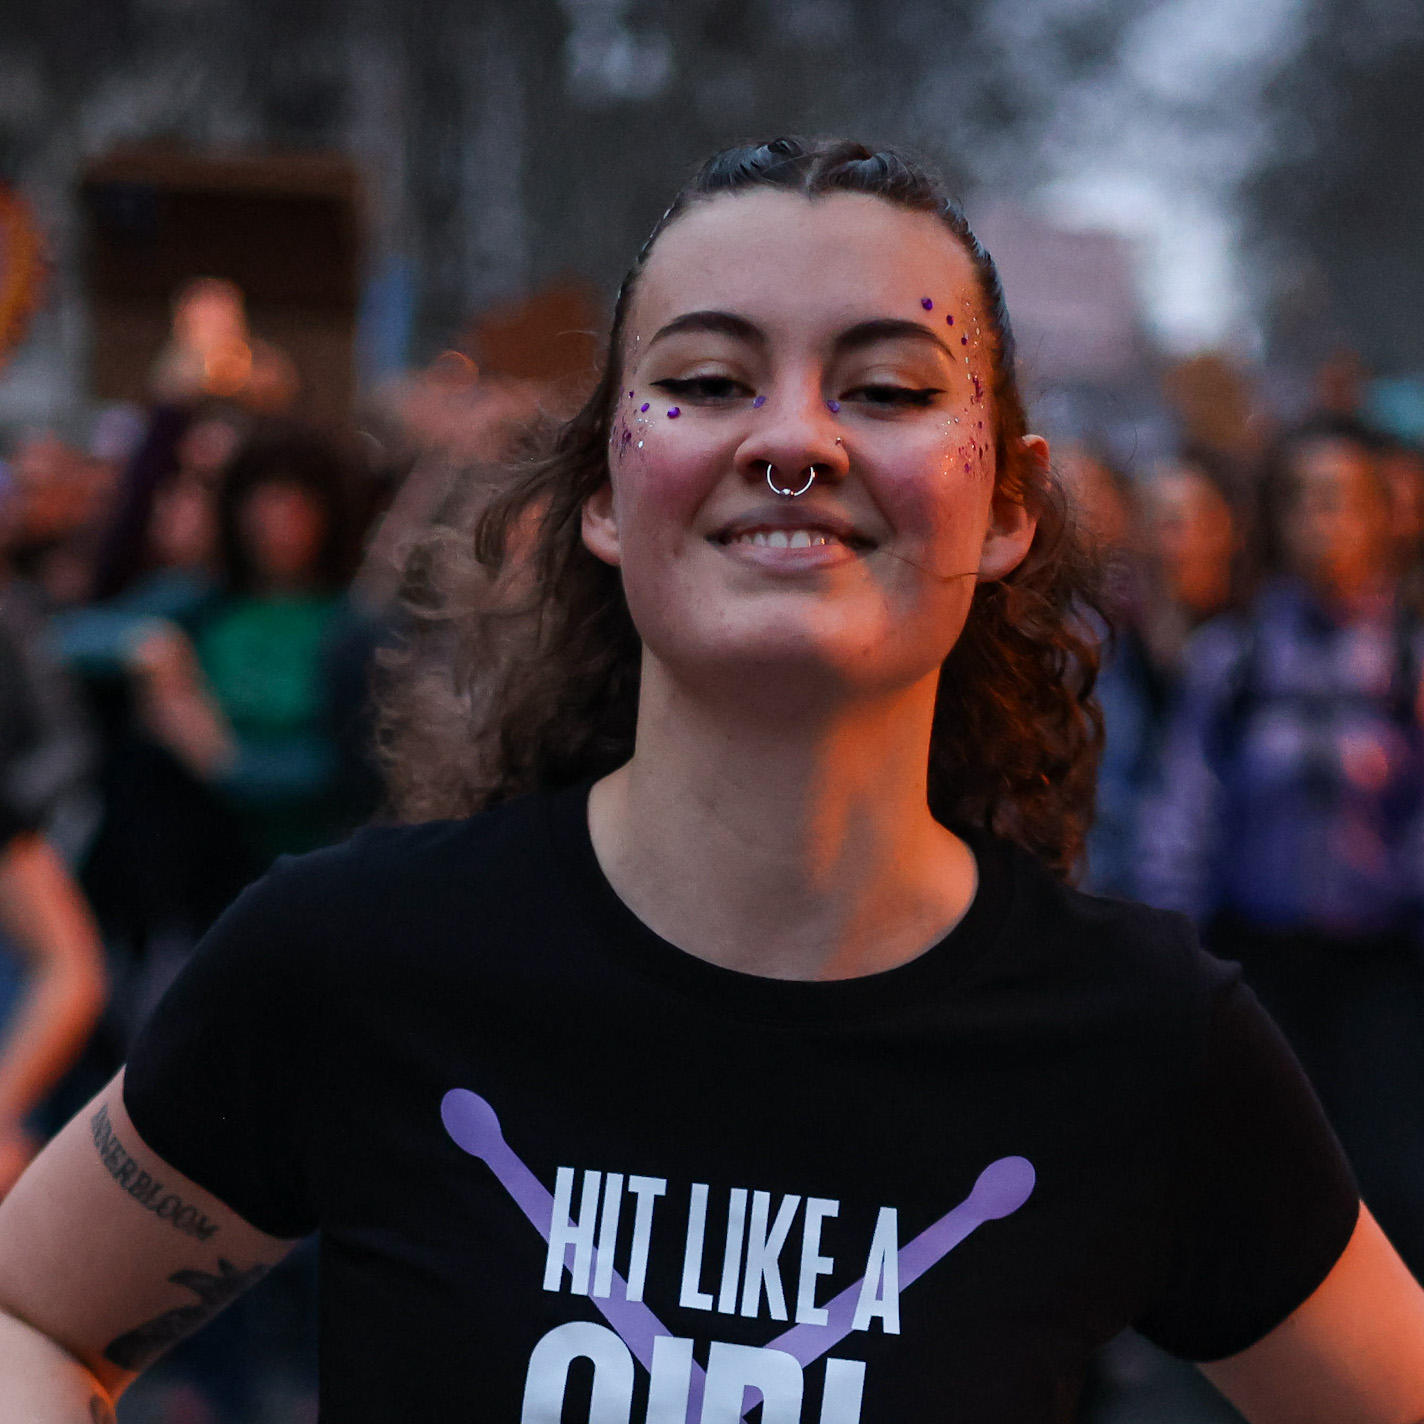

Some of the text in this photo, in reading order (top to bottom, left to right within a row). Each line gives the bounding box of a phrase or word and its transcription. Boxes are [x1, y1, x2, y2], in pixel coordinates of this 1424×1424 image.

[543, 1166, 901, 1335] HIT LIKE A
